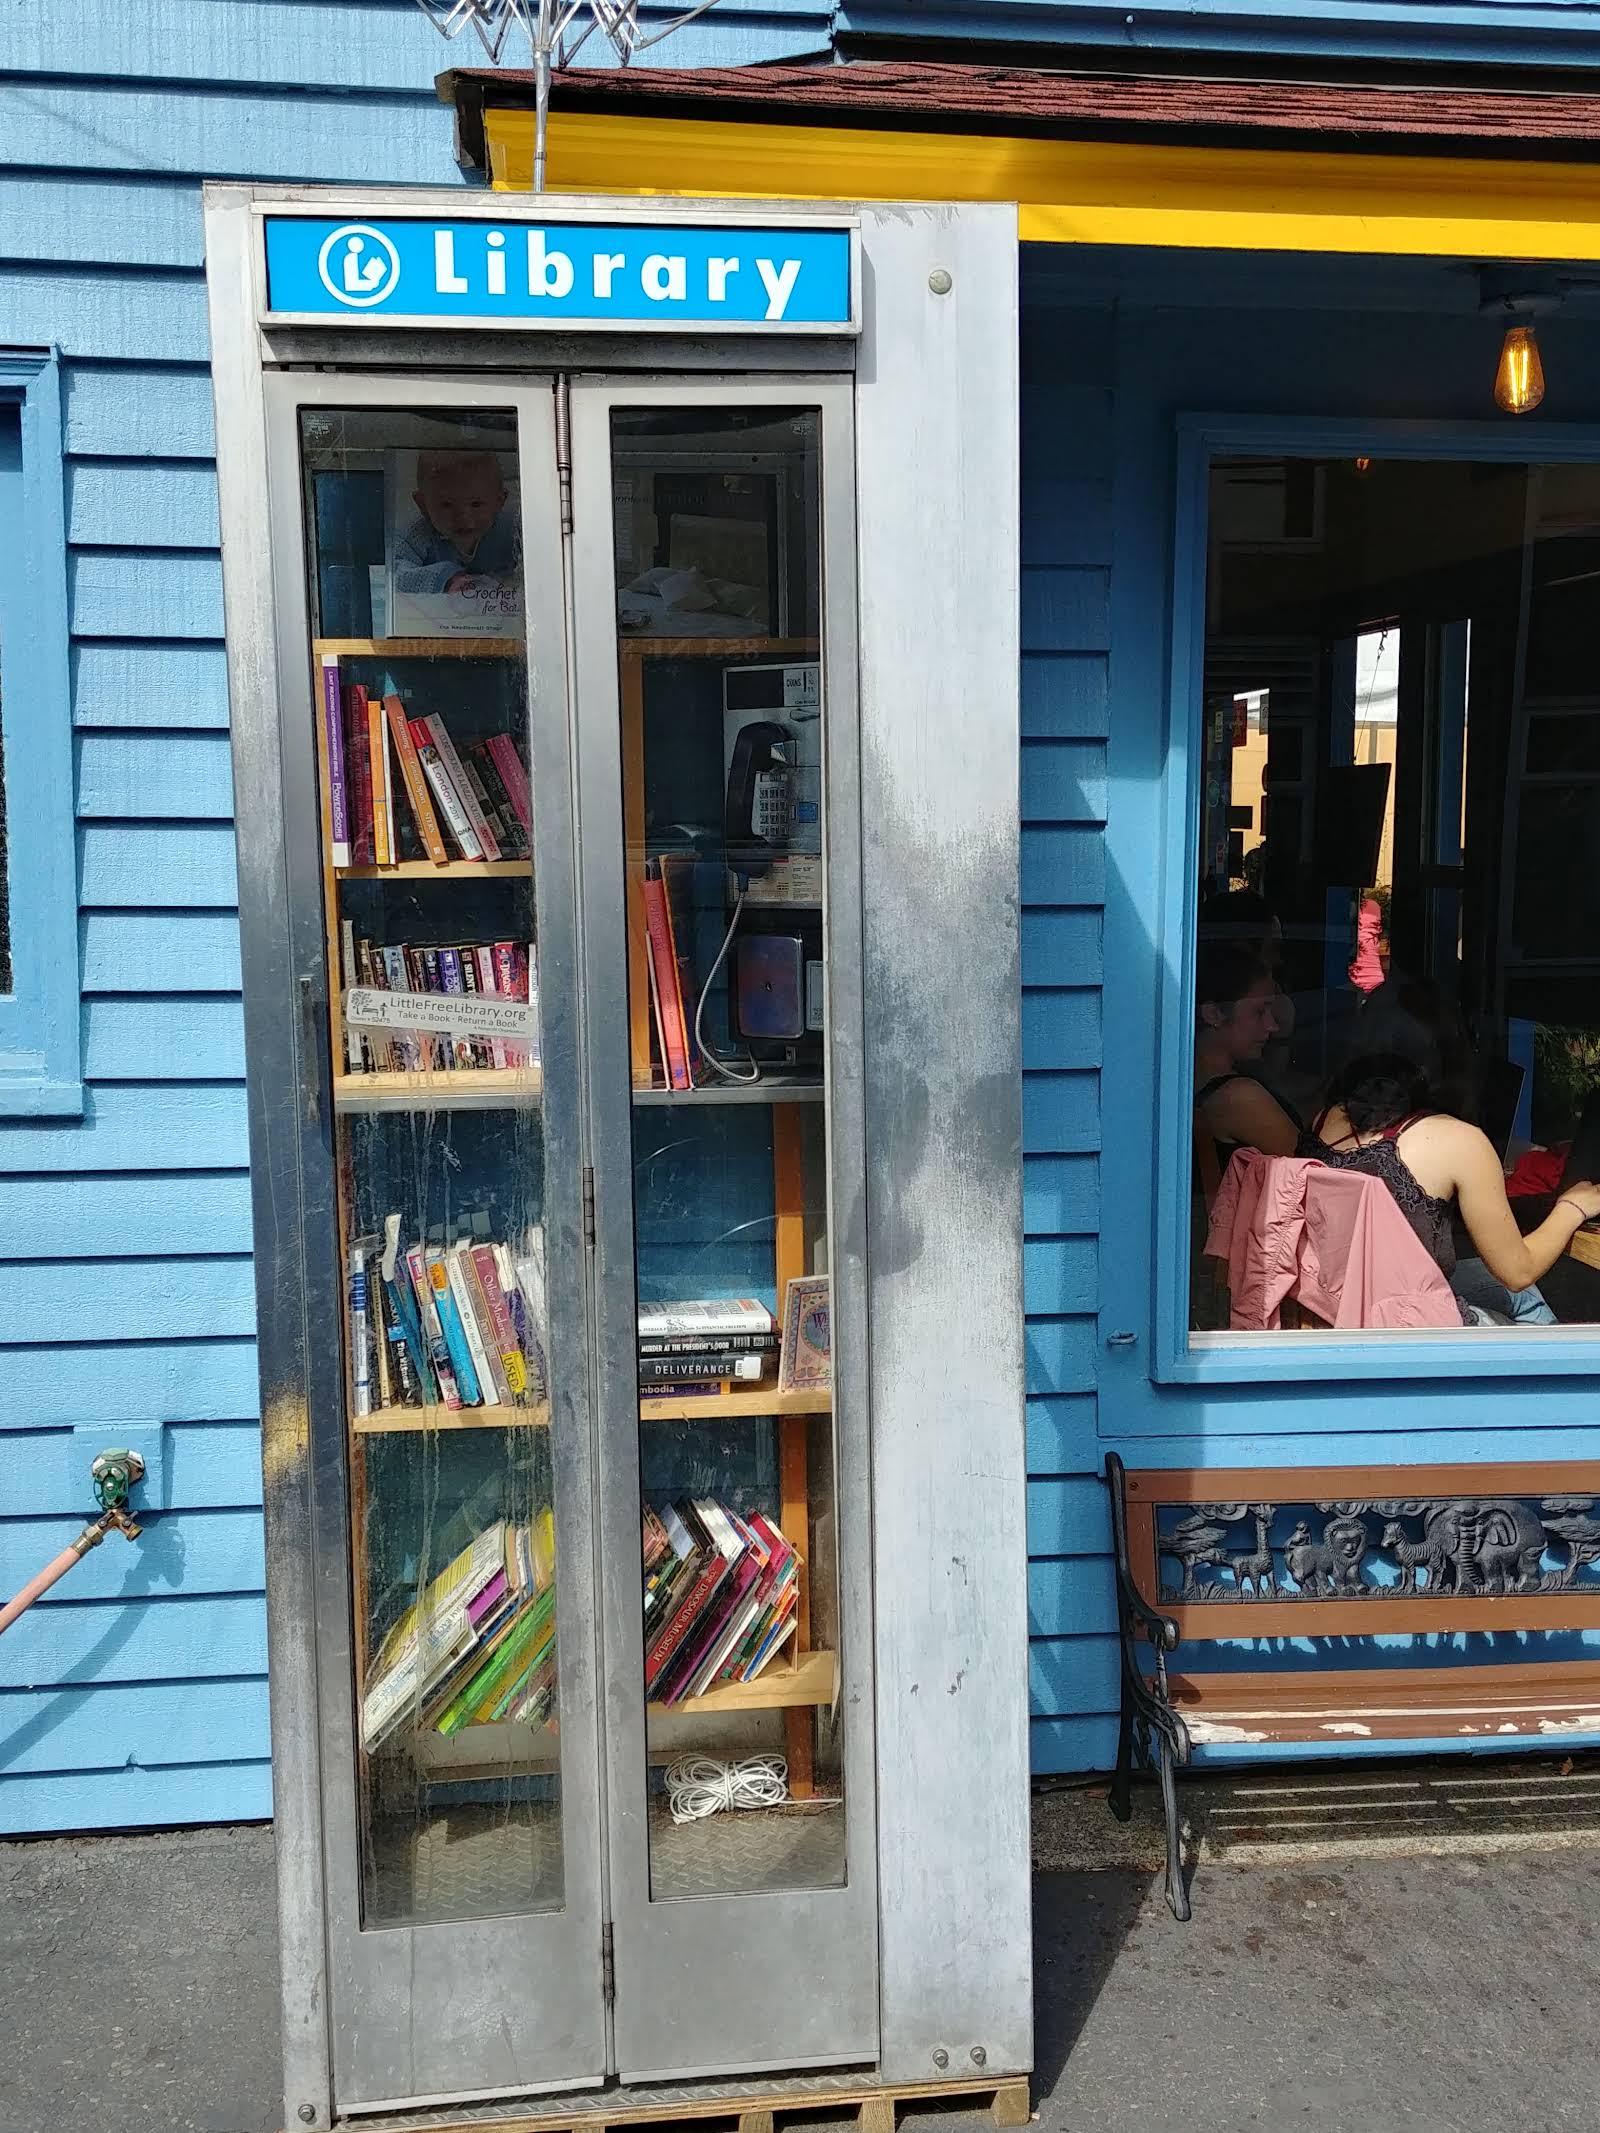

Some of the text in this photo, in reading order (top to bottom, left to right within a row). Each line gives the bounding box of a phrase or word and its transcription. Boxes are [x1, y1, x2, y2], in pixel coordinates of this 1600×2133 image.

[434, 230, 803, 320] Library
[460, 582, 516, 600] Crochet
[433, 764, 460, 820] London 2011
[390, 997, 526, 1021] LittleFreeLibrary.org
[398, 1010, 418, 1020] Take
[428, 1013, 451, 1022] Book
[458, 1015, 487, 1025] Return
[496, 1019, 518, 1028] Book
[484, 1273, 498, 1301] Other
[640, 1344, 663, 1353] MURDER
[663, 1344, 671, 1352] AT
[671, 1343, 682, 1352] THE
[682, 1342, 714, 1351] PRESIDENT'S
[396, 1341, 410, 1388] The Witness
[503, 1356, 520, 1388] USED
[655, 1364, 731, 1375] DELIVERANCE
[640, 1384, 675, 1394] mbodia
[475, 1574, 490, 1590] EGG
[676, 1582, 709, 1624] DINOSAUR
[652, 1621, 683, 1662] MUSEUM
